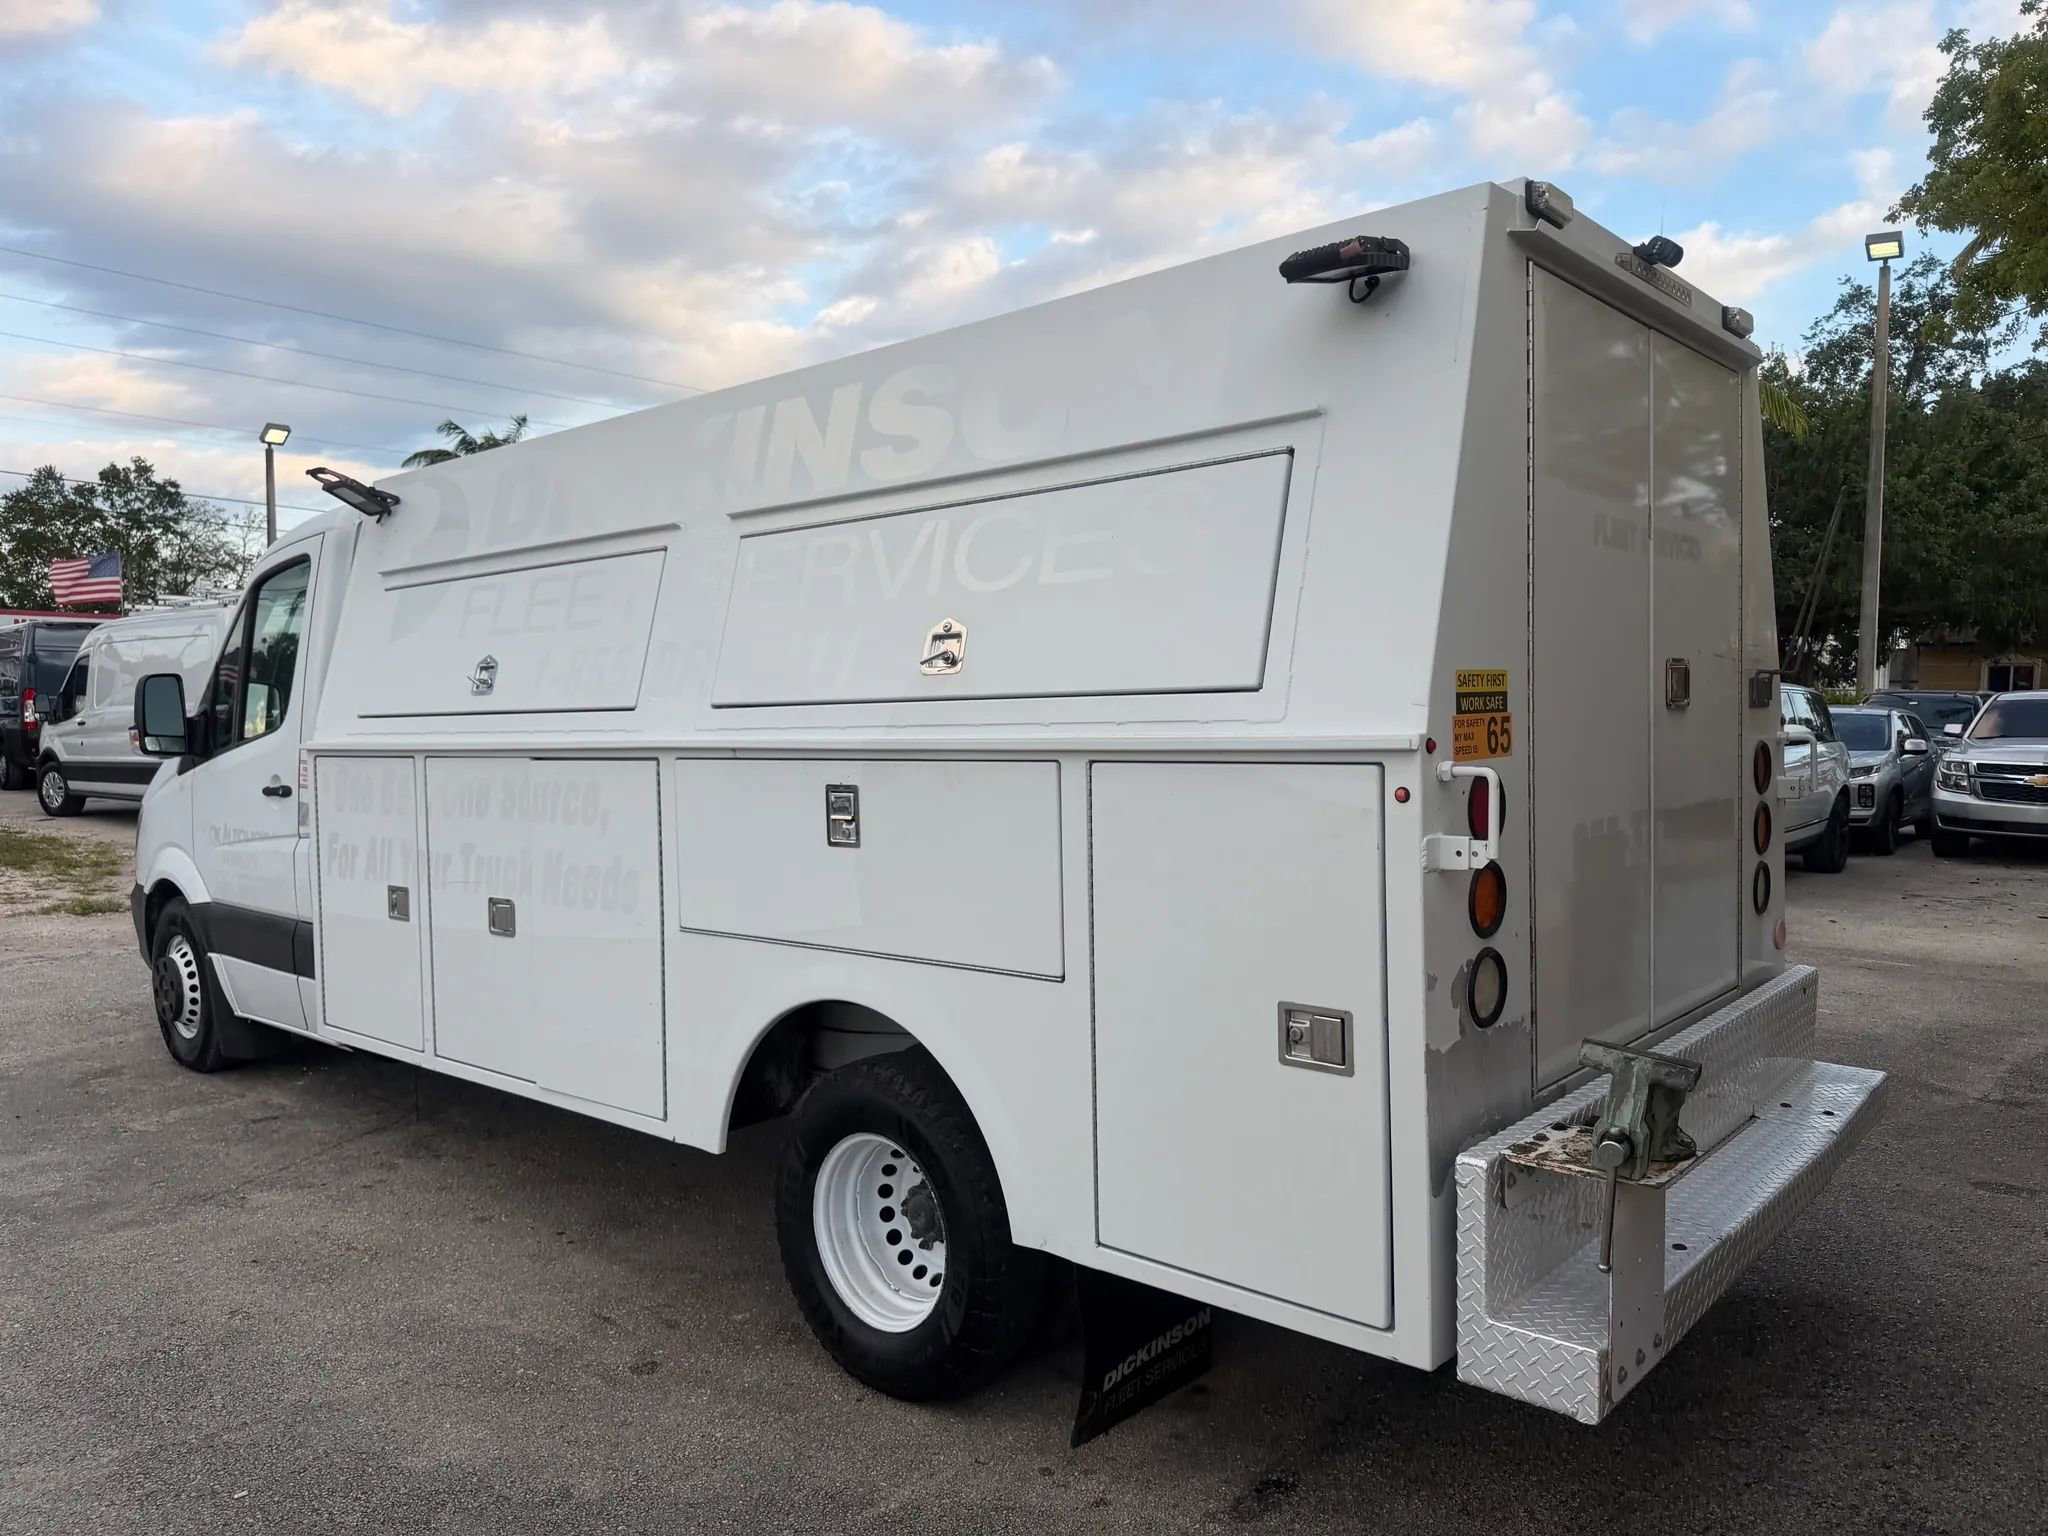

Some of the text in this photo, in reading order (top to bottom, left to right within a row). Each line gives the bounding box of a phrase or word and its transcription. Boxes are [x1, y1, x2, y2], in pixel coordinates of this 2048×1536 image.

[1457, 673, 1506, 688] SAFETY FIRST
[1460, 696, 1504, 711] WORK SAFE
[1454, 718, 1485, 729] FOR SAFETY
[1464, 732, 1475, 741] MAX
[1487, 716, 1512, 755] 65
[1454, 746, 1472, 756] SPEED
[1102, 1306, 1211, 1393] DICKINSON
